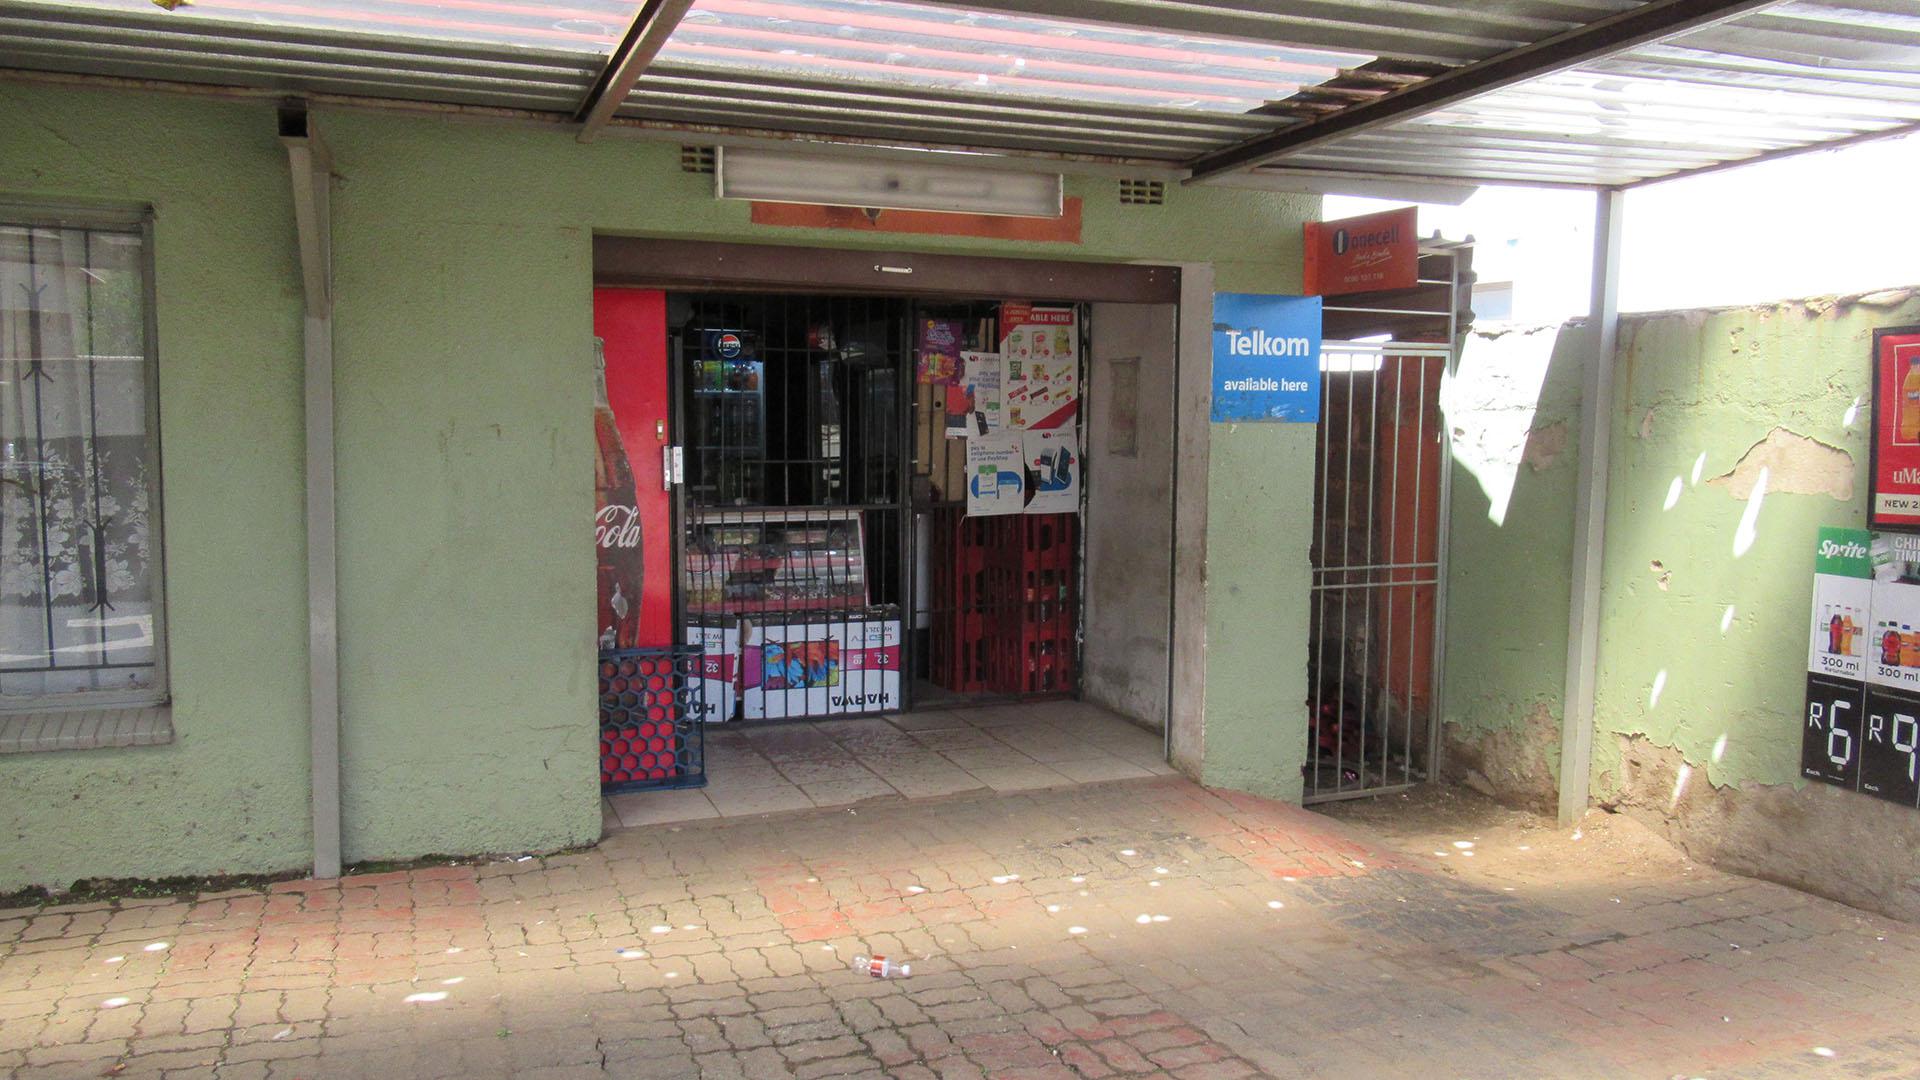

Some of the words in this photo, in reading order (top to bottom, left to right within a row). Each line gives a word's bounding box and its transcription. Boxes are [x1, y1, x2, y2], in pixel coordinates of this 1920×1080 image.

[1351, 223, 1400, 249] onecell
[1051, 313, 1070, 322] HERE
[1225, 330, 1310, 357] Telkom
[1224, 377, 1279, 392] available
[1281, 377, 1308, 392] here
[1885, 500, 1909, 508] NEW
[1818, 539, 1867, 559] Sprite
[877, 655, 889, 664] 32
[1821, 656, 1843, 668] 300
[1846, 662, 1860, 671] ml
[706, 663, 719, 673] 32
[1878, 666, 1901, 679] 300
[1904, 672, 1919, 682] ml
[1809, 702, 1823, 730] R
[1827, 699, 1852, 765] 6
[1868, 714, 1884, 744] R
[1892, 713, 1918, 783] 9
[1864, 783, 1880, 792] Each
